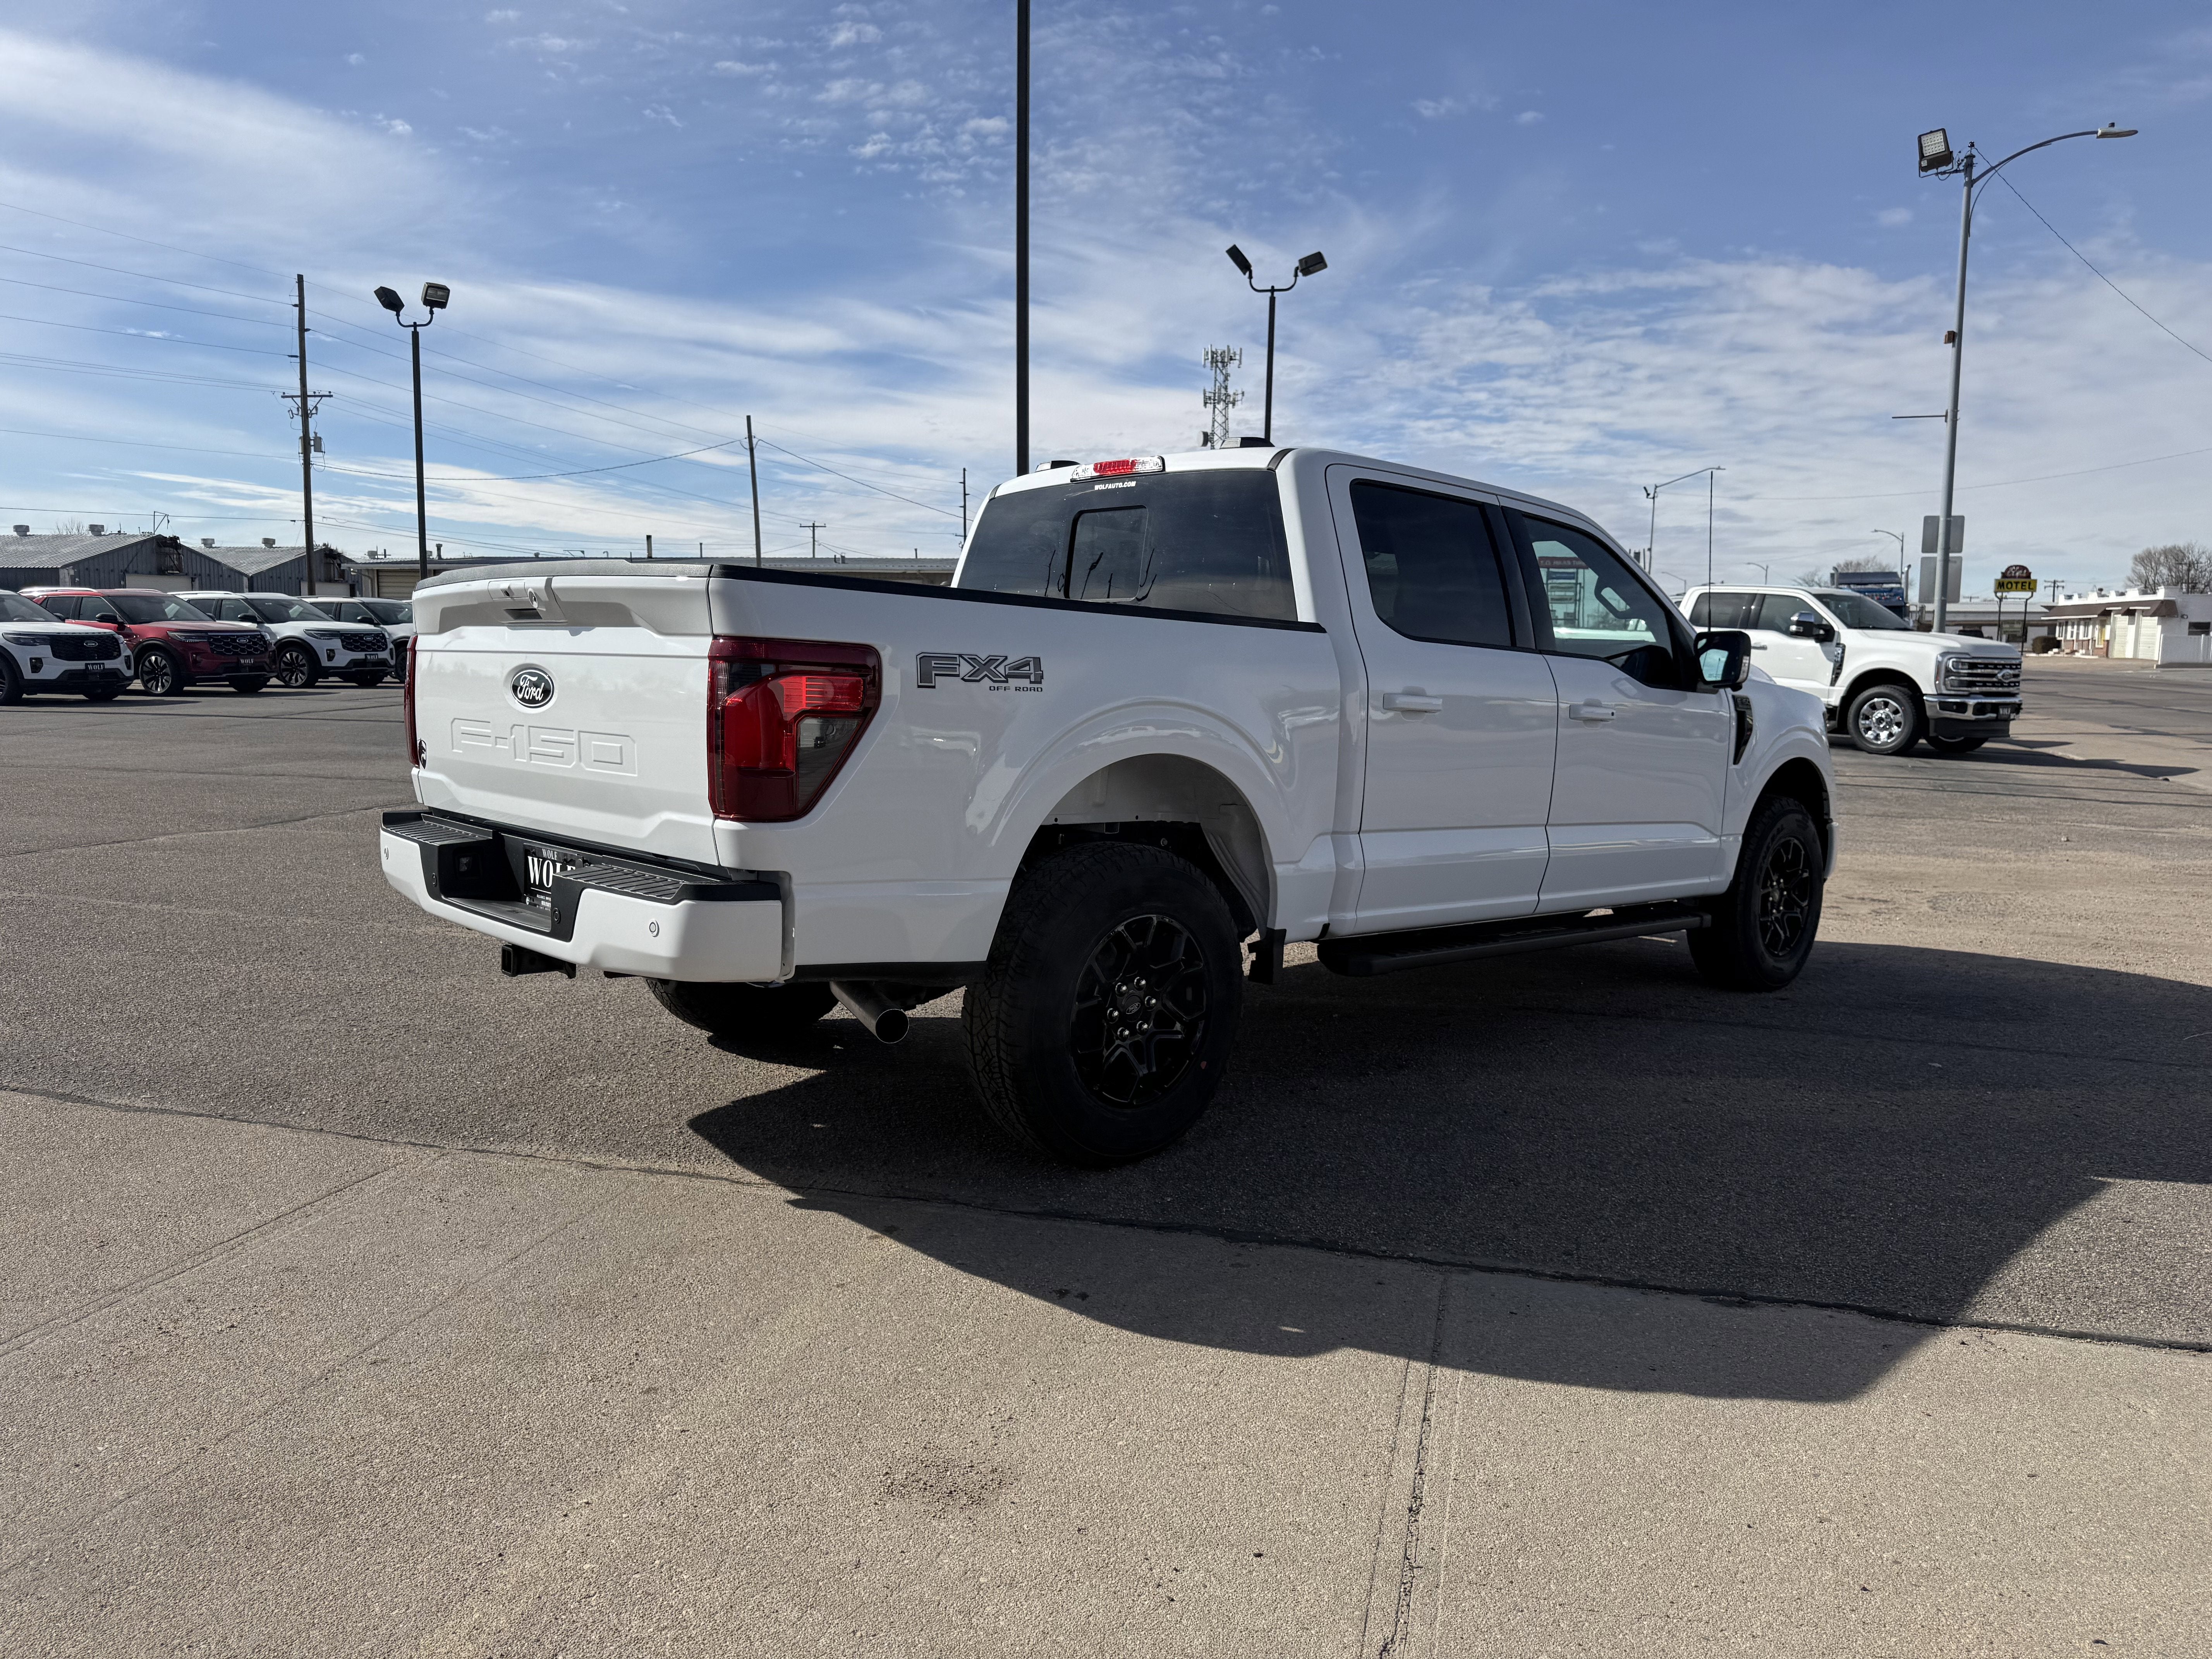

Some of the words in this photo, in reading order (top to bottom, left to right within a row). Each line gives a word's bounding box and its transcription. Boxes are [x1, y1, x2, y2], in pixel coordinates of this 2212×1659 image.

[1094, 481, 1136, 490] WOLFAUTO.COM
[1997, 581, 2033, 590] MOTEL
[916, 653, 1044, 689] FX4
[517, 674, 545, 701] Ford
[451, 718, 638, 777] F-150
[542, 848, 558, 860] WOLF
[527, 856, 576, 888] WO
